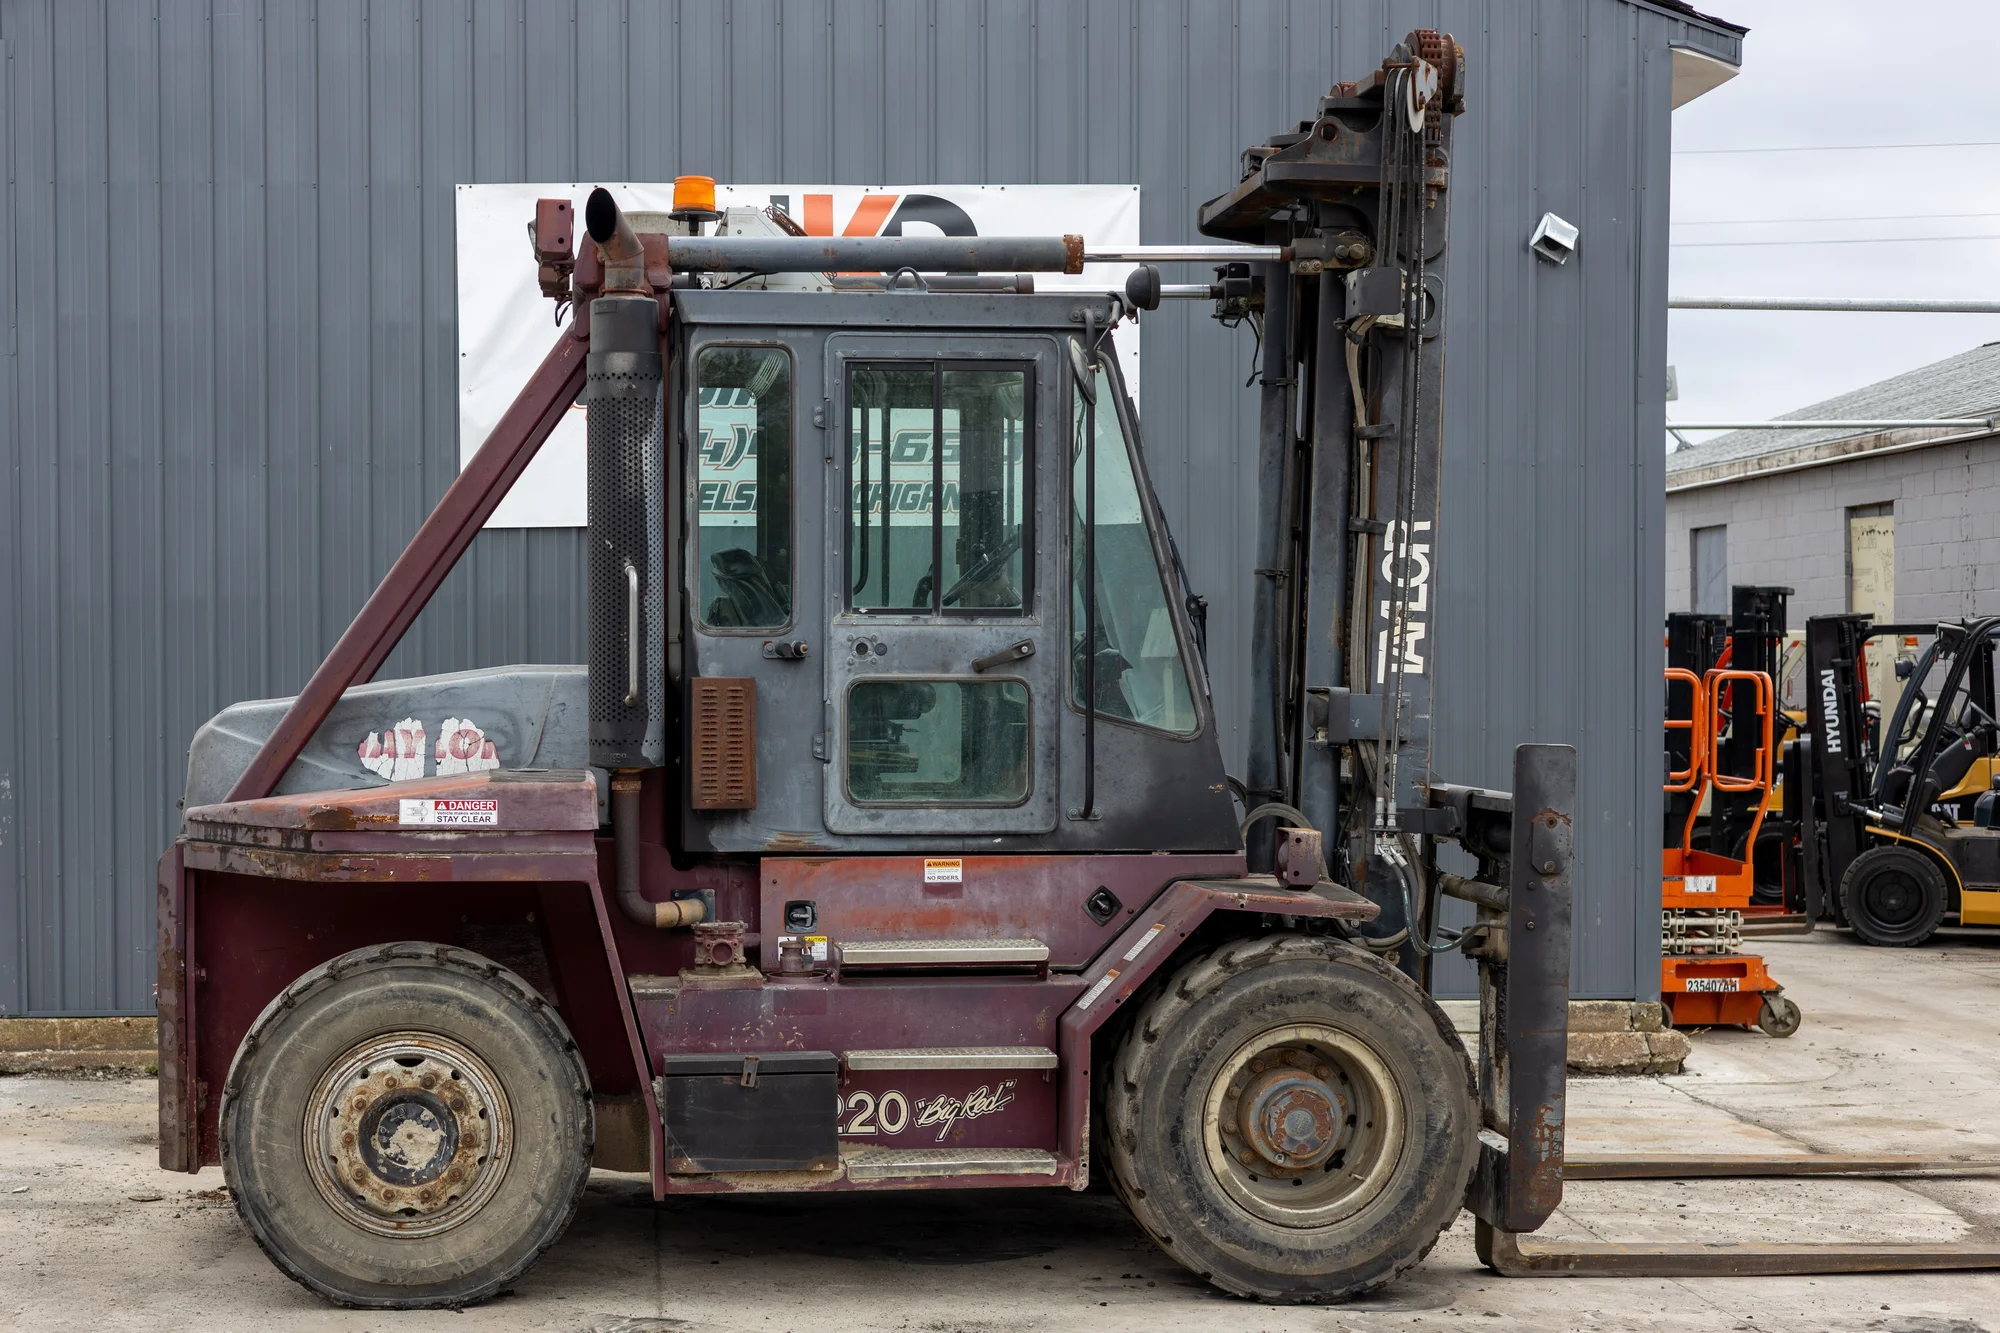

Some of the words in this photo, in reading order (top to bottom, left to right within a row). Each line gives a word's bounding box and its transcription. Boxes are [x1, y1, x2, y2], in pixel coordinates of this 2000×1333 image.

[1820, 669, 1842, 753] HYUNDAI
[437, 815, 458, 823] STAY
[461, 815, 491, 823] CLEAR
[449, 801, 494, 810] DANGER
[838, 1090, 910, 1135] 20
